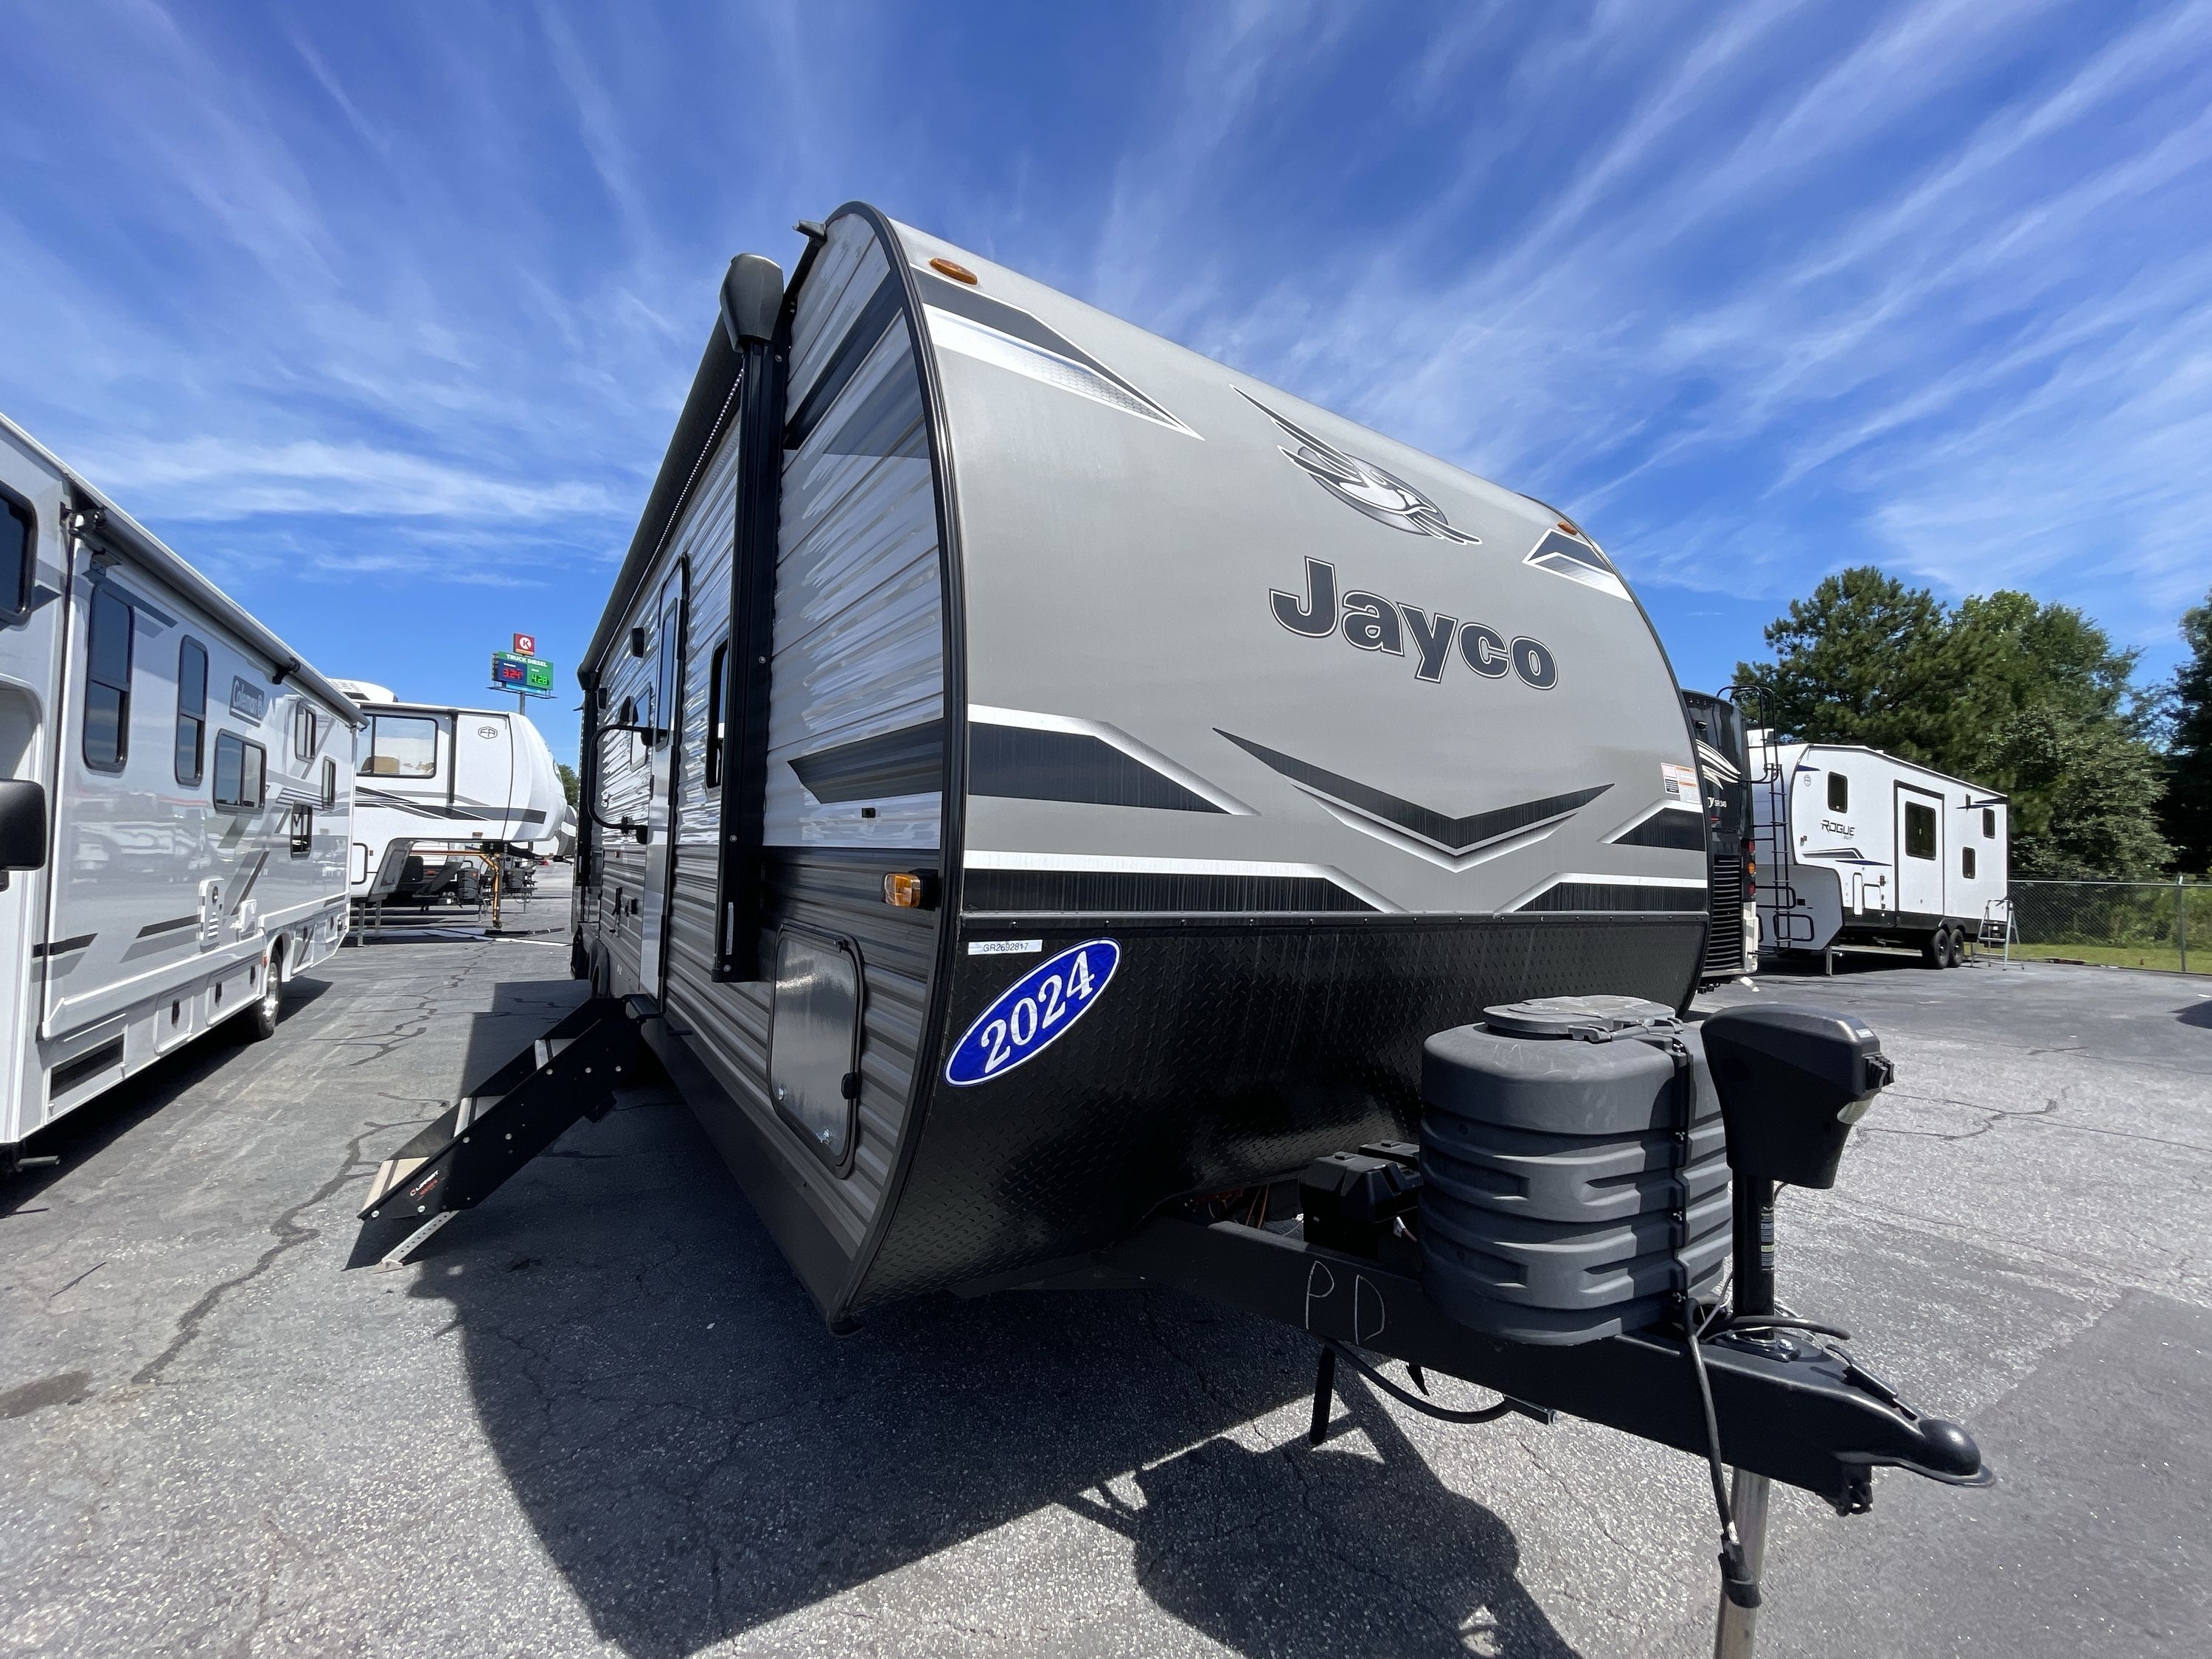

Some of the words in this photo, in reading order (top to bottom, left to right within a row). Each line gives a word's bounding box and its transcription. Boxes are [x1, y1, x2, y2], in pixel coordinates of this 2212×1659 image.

[1269, 555, 1558, 690] Jayco
[506, 653, 527, 663] TRUCK
[527, 658, 548, 667] DIESEL
[1820, 819, 1856, 836] ROGUE
[981, 950, 1095, 1074] 2024
